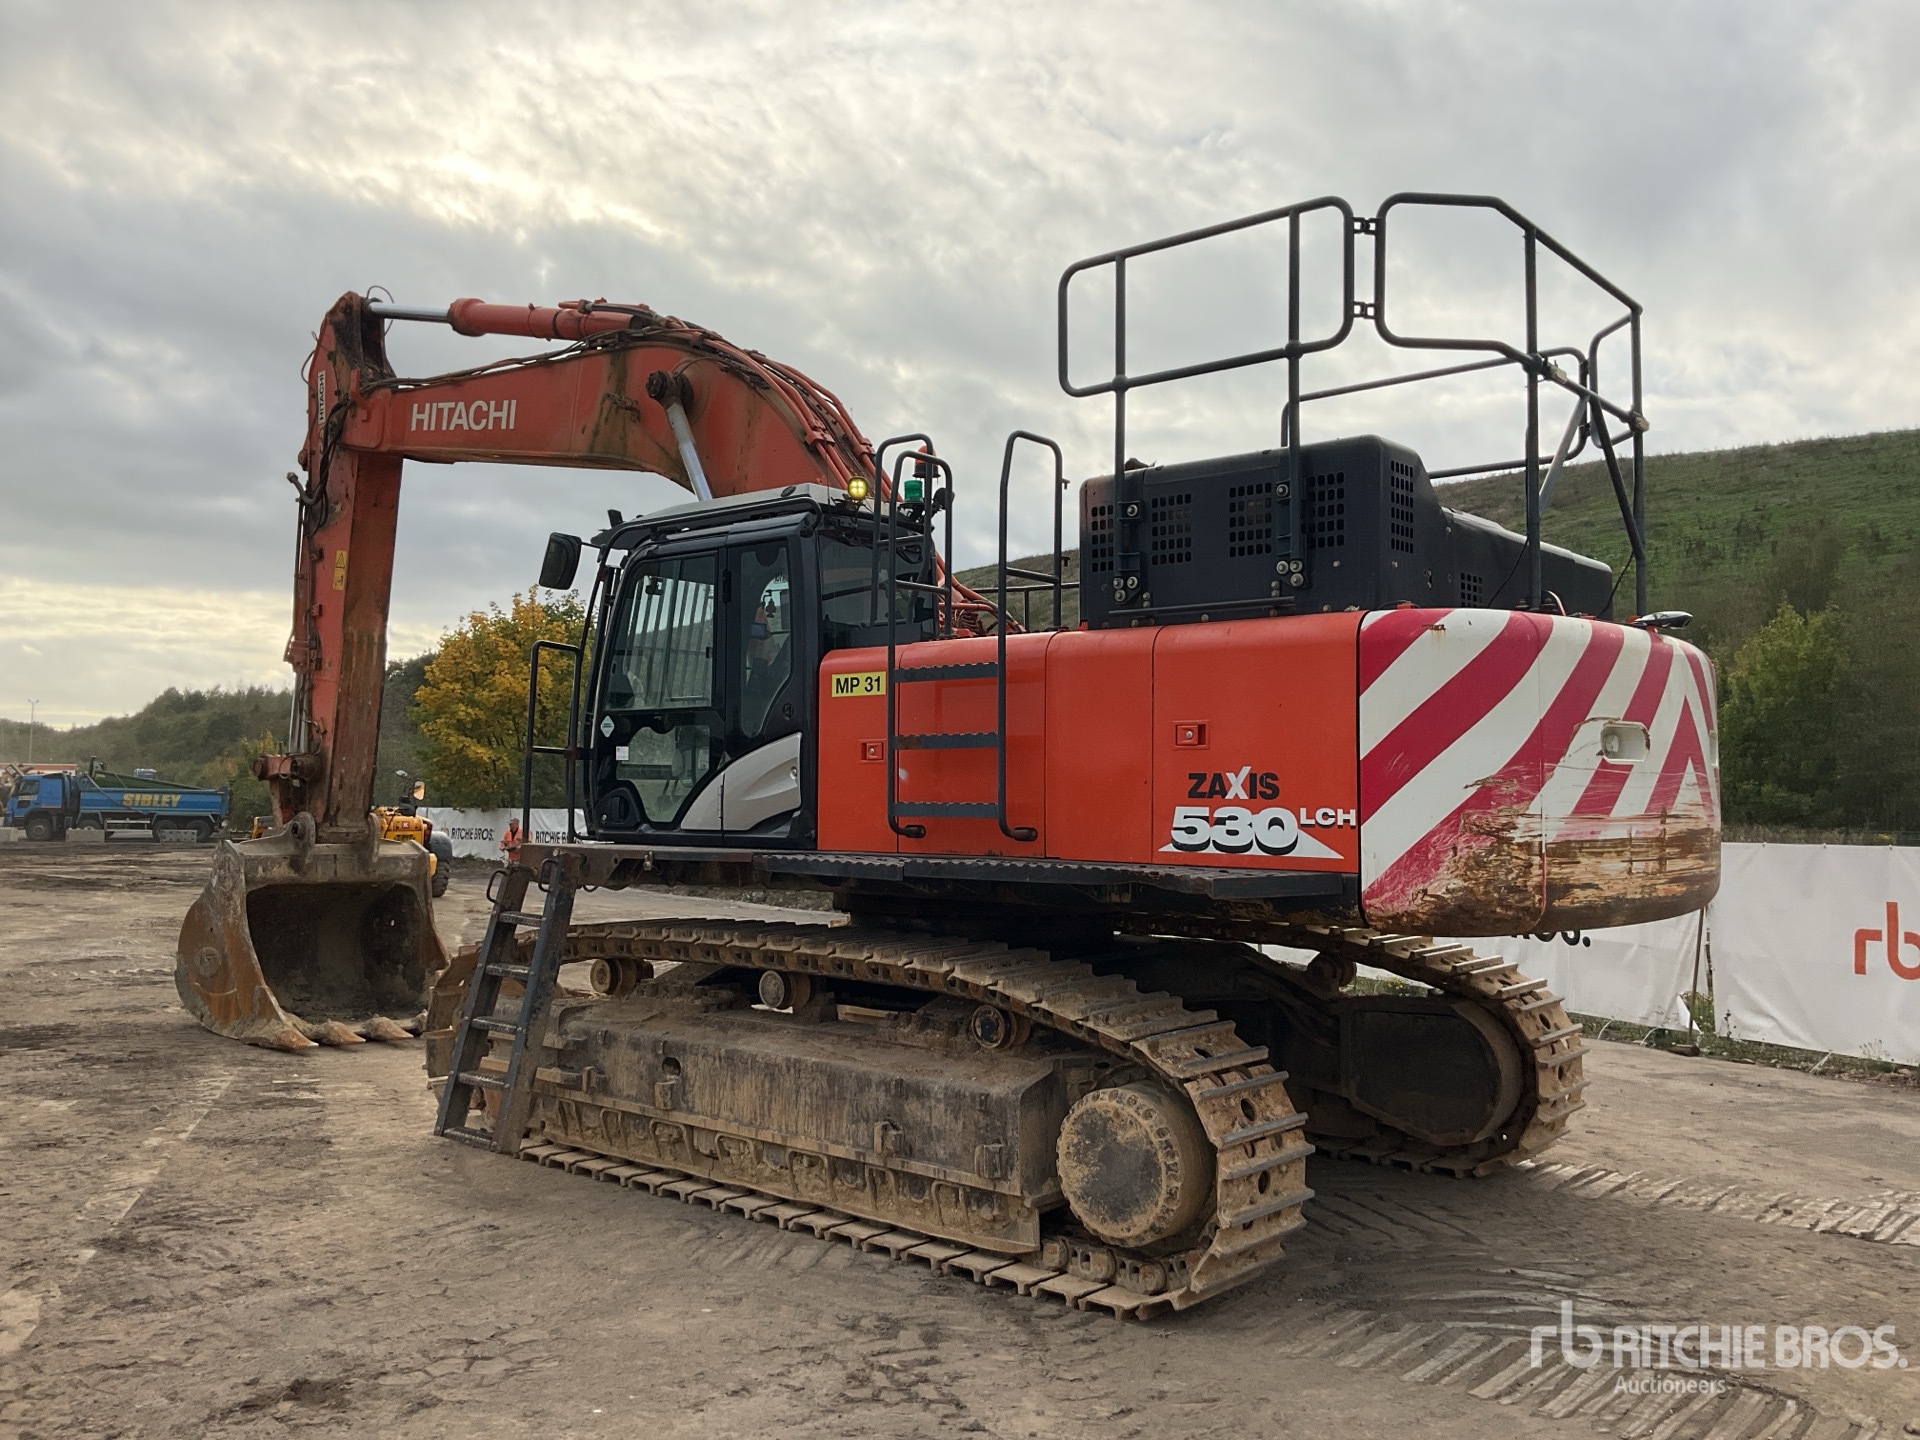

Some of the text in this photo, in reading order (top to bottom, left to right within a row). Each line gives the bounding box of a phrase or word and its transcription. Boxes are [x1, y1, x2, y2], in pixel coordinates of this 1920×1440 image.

[410, 399, 518, 431] HITACHI
[835, 675, 881, 694] MP 31
[1187, 766, 1280, 800] ZAXIS
[122, 793, 182, 808] SIBLEY
[1170, 806, 1357, 856] 530 LCH
